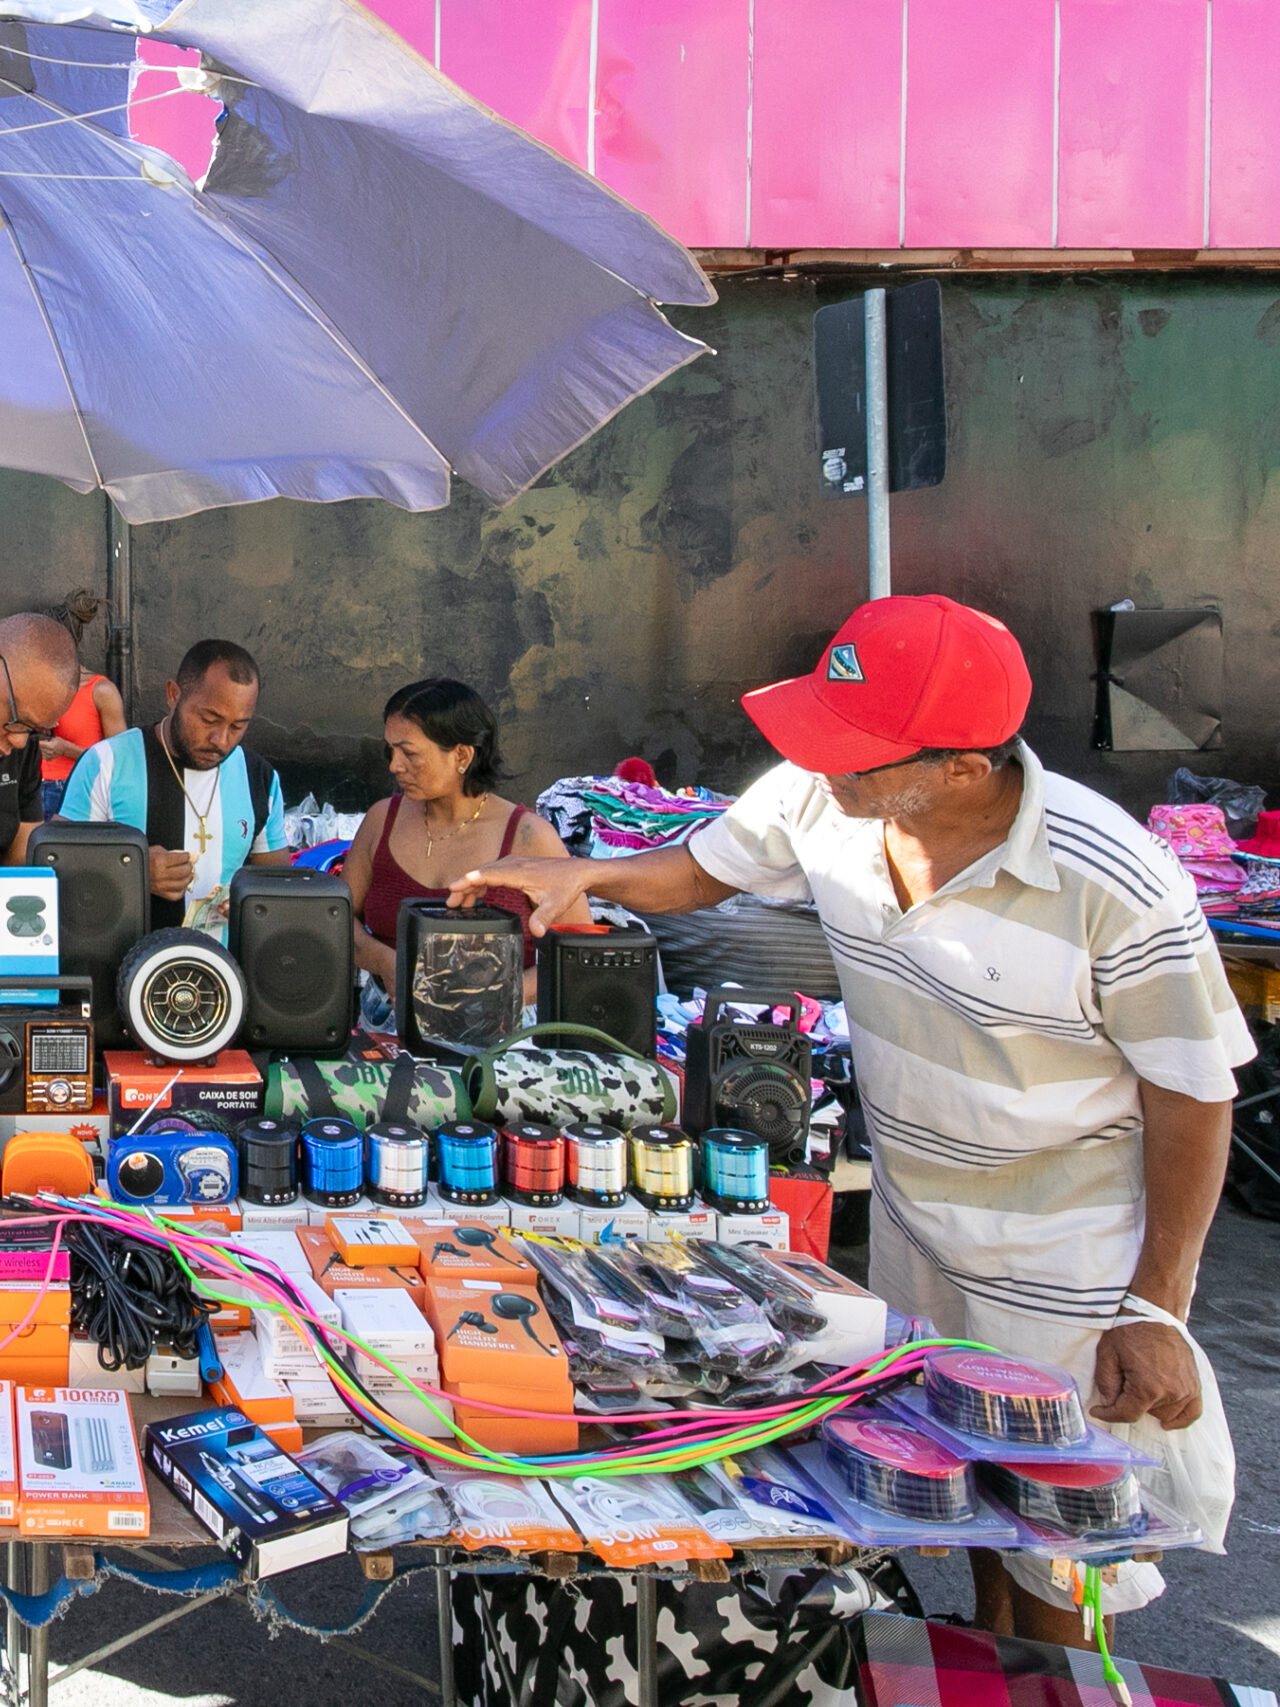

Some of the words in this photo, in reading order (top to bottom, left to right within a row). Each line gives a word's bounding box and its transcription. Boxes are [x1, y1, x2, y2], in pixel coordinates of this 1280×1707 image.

[199, 1091, 225, 1100] CAIXA
[226, 1091, 238, 1100] DE
[238, 1091, 258, 1100] SOM
[217, 1100, 257, 1109] PORTÁTIL
[5, 1256, 41, 1267] wireless
[460, 1340, 516, 1350] HANDSFREE
[600, 1525, 662, 1546] SOM
